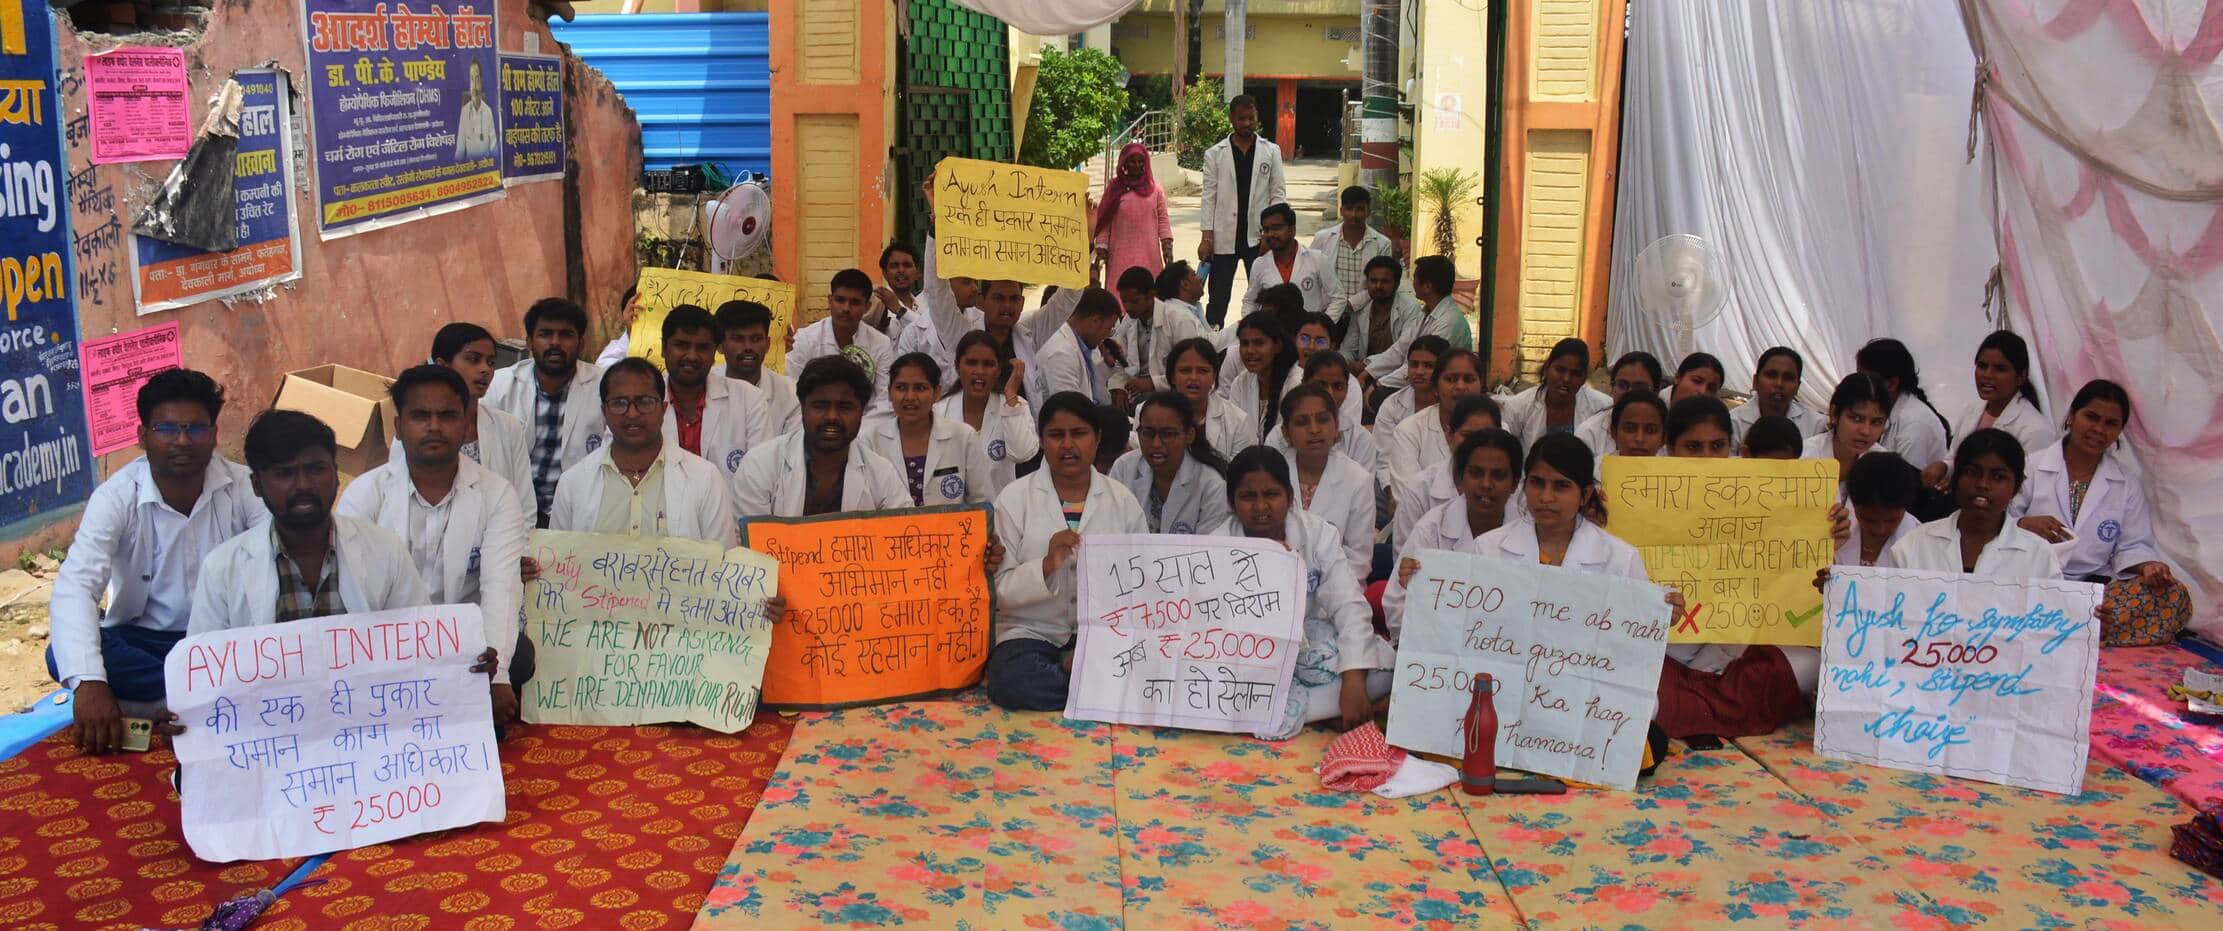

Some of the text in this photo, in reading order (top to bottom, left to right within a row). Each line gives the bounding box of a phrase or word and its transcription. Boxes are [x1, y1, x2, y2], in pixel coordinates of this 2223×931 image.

[311, 3, 492, 52] आदर्श होम्यो हॉल
[326, 64, 349, 87] डा.
[403, 55, 446, 81] पाण्डेय
[512, 69, 526, 92] राम
[325, 146, 343, 163] चर्म
[346, 144, 364, 161] रोग
[366, 140, 380, 158] एवं
[409, 136, 425, 153] रोग
[240, 181, 283, 203] कम्पनी की
[943, 168, 1077, 208] Ayush Intern
[240, 201, 275, 221] उचित रेट
[944, 204, 971, 227] एक
[976, 200, 990, 227] ही
[943, 236, 971, 257] काम
[973, 239, 992, 260] का
[1032, 235, 1081, 273] अधिकार
[1620, 461, 1838, 511] हमारा हक हमारी
[1688, 516, 1771, 540] आवाज
[536, 544, 583, 592] Duty
[766, 537, 824, 574] Stipend
[831, 535, 876, 563] हमारा
[884, 525, 954, 561] अधिकार
[1717, 538, 1835, 570] INCREMENT
[819, 563, 907, 597] अभिमान
[1109, 555, 1145, 597] 15
[1153, 550, 1215, 593] साल
[1708, 577, 1745, 599] बार
[680, 596, 715, 625] इतना
[880, 599, 930, 629] हमारा
[1131, 598, 1191, 630] 7,500
[1195, 598, 1221, 622] पर
[1223, 590, 1281, 618] विराम
[1429, 578, 1668, 642] 7500 me ab nahi
[1917, 592, 1962, 641] ko
[188, 617, 461, 692] AYUSH INTERN
[541, 619, 754, 665] WE ARE NOT ASKING
[800, 633, 850, 679] कोई
[856, 633, 936, 675] एहसान
[1113, 639, 1146, 677] अब
[1184, 628, 1275, 659] 25,000
[1465, 621, 1615, 683] hota guzara
[604, 653, 706, 683] FOR FAVOUR
[1143, 680, 1175, 704] का
[1184, 665, 1212, 709] हो
[206, 679, 440, 735] की एक ही पुकार
[536, 678, 568, 709] WE
[575, 675, 609, 714] ARE
[696, 681, 723, 719] OUR
[1585, 697, 1631, 735] haq
[334, 724, 390, 752] काम
[412, 715, 443, 741] का
[281, 761, 358, 807] समान
[351, 783, 441, 829] 25000
